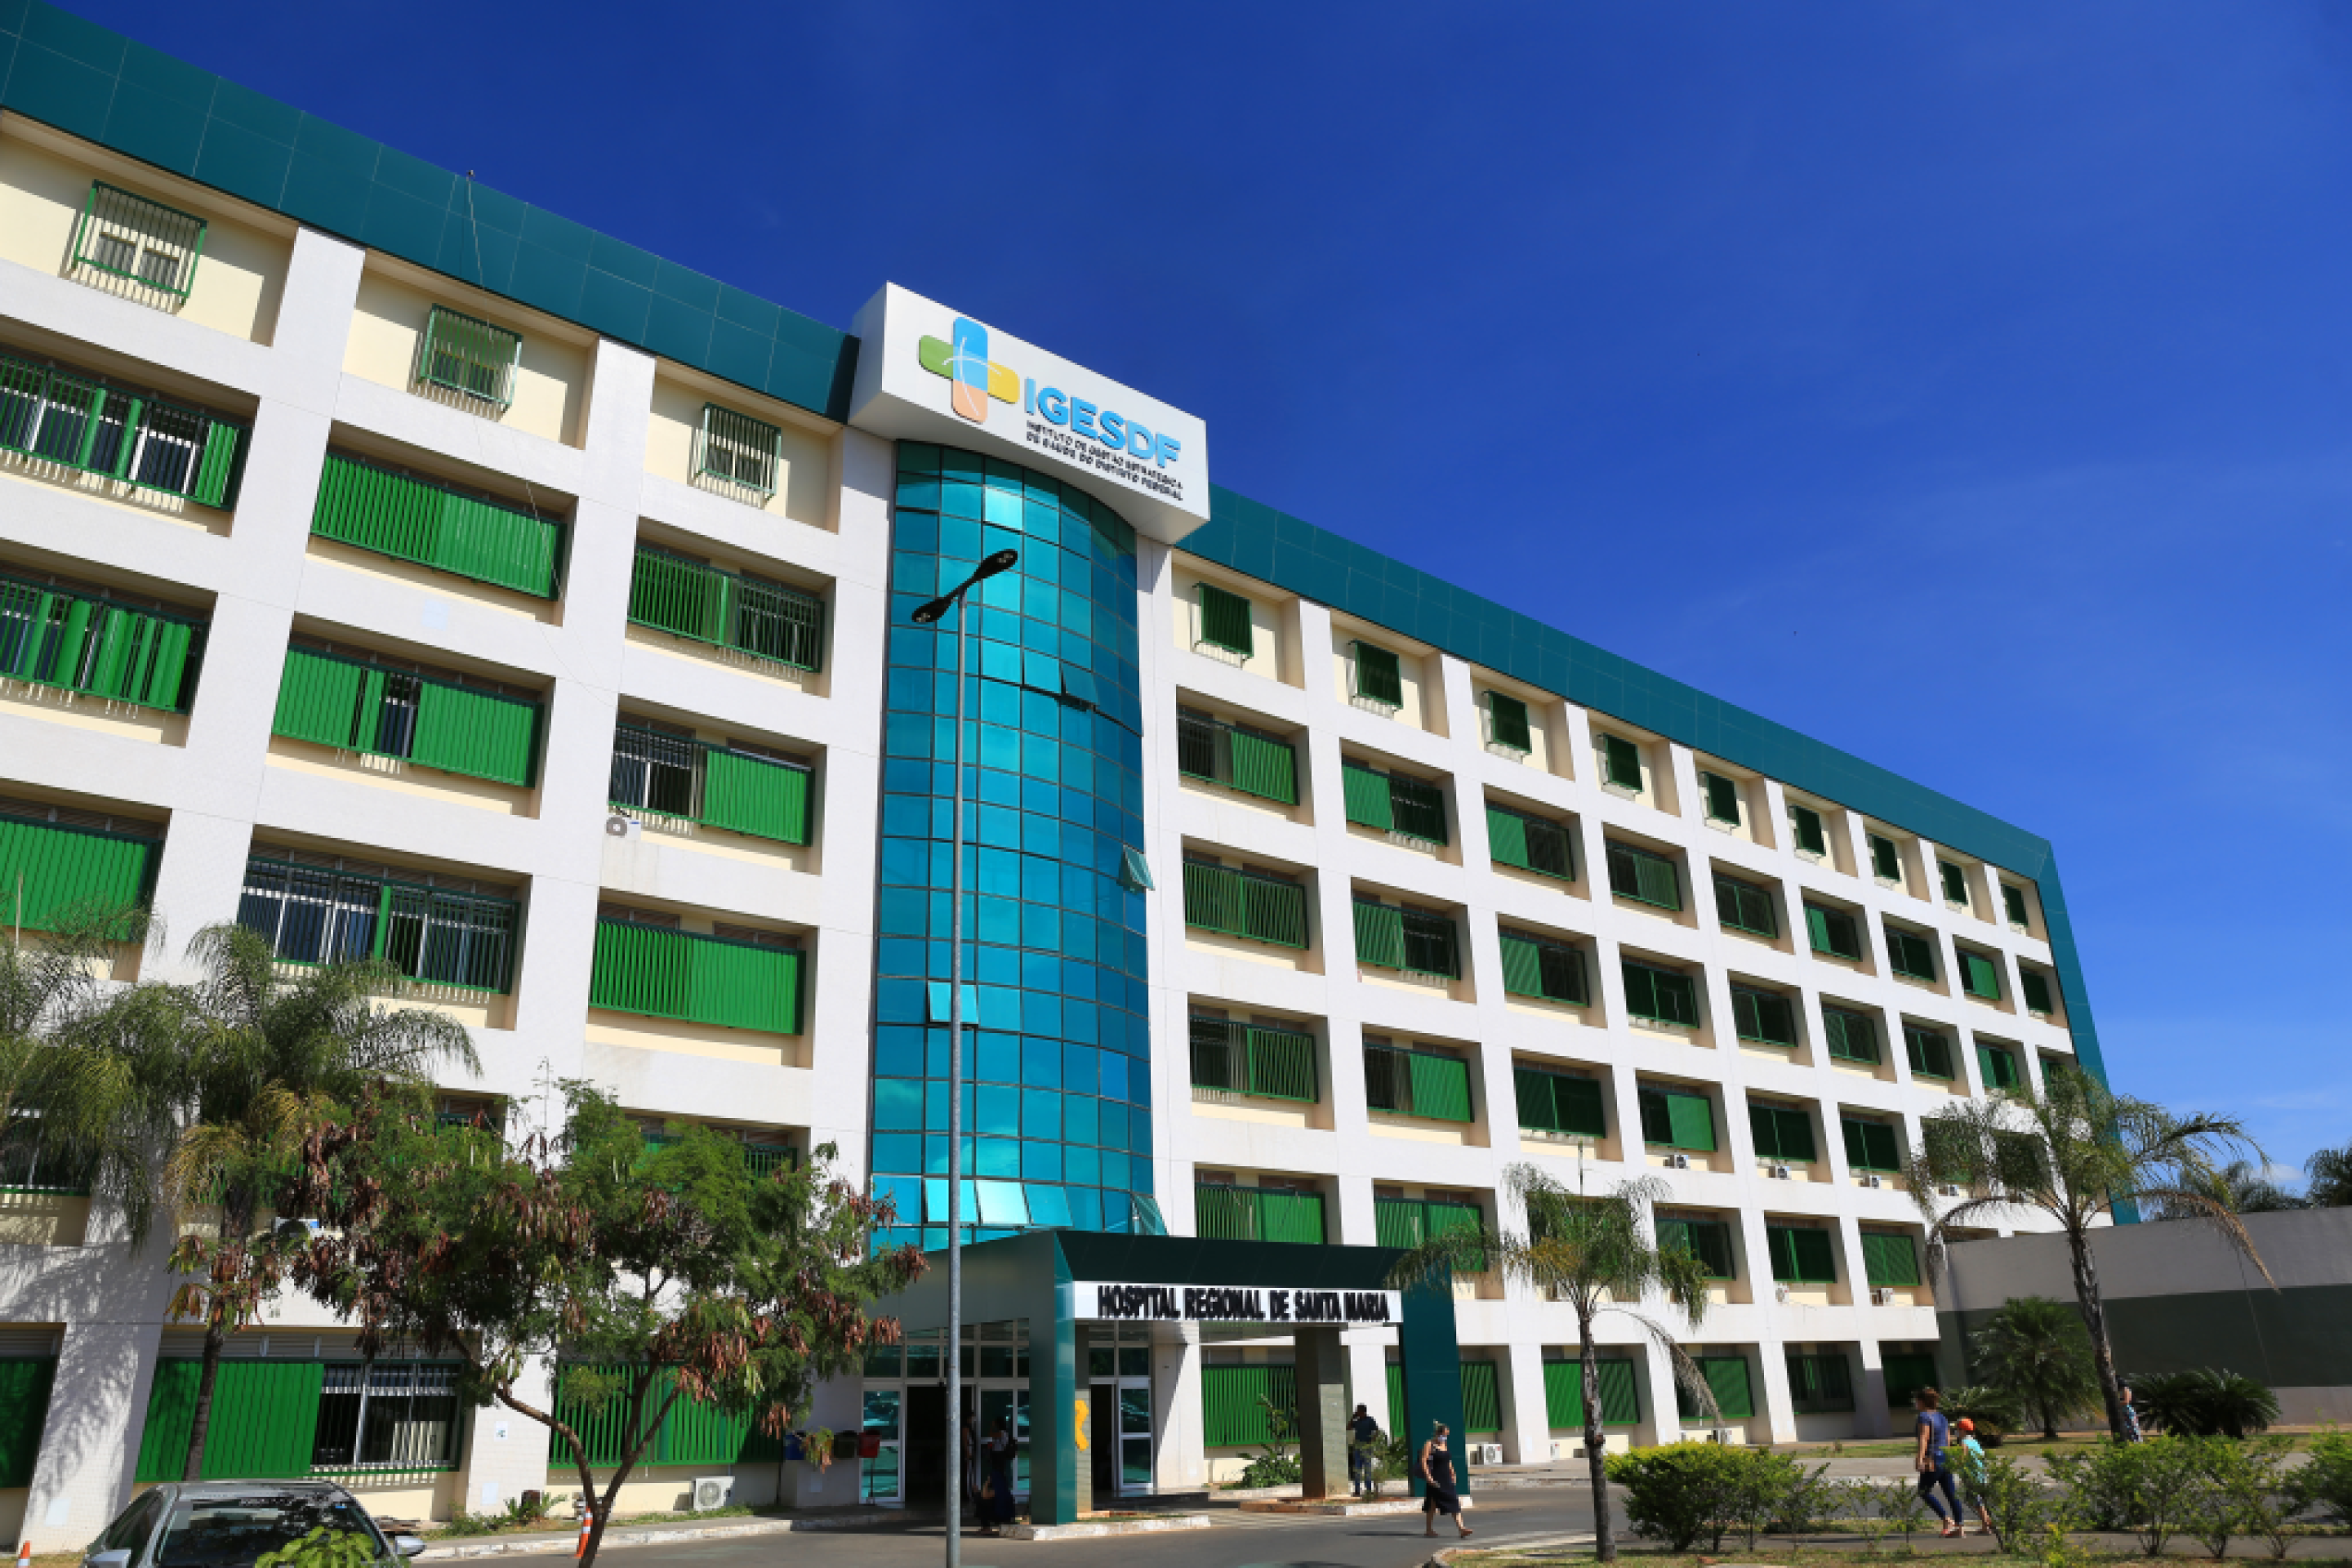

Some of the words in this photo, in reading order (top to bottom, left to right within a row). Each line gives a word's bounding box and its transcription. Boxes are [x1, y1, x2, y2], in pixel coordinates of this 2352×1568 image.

[1024, 377, 1181, 468] IGESDF
[1098, 1285, 1181, 1320] HOSPITAL
[1183, 1287, 1265, 1321] REGIONAL
[1268, 1290, 1290, 1321] DE
[1294, 1290, 1342, 1321] SANTA
[1343, 1291, 1390, 1321] MARIA
